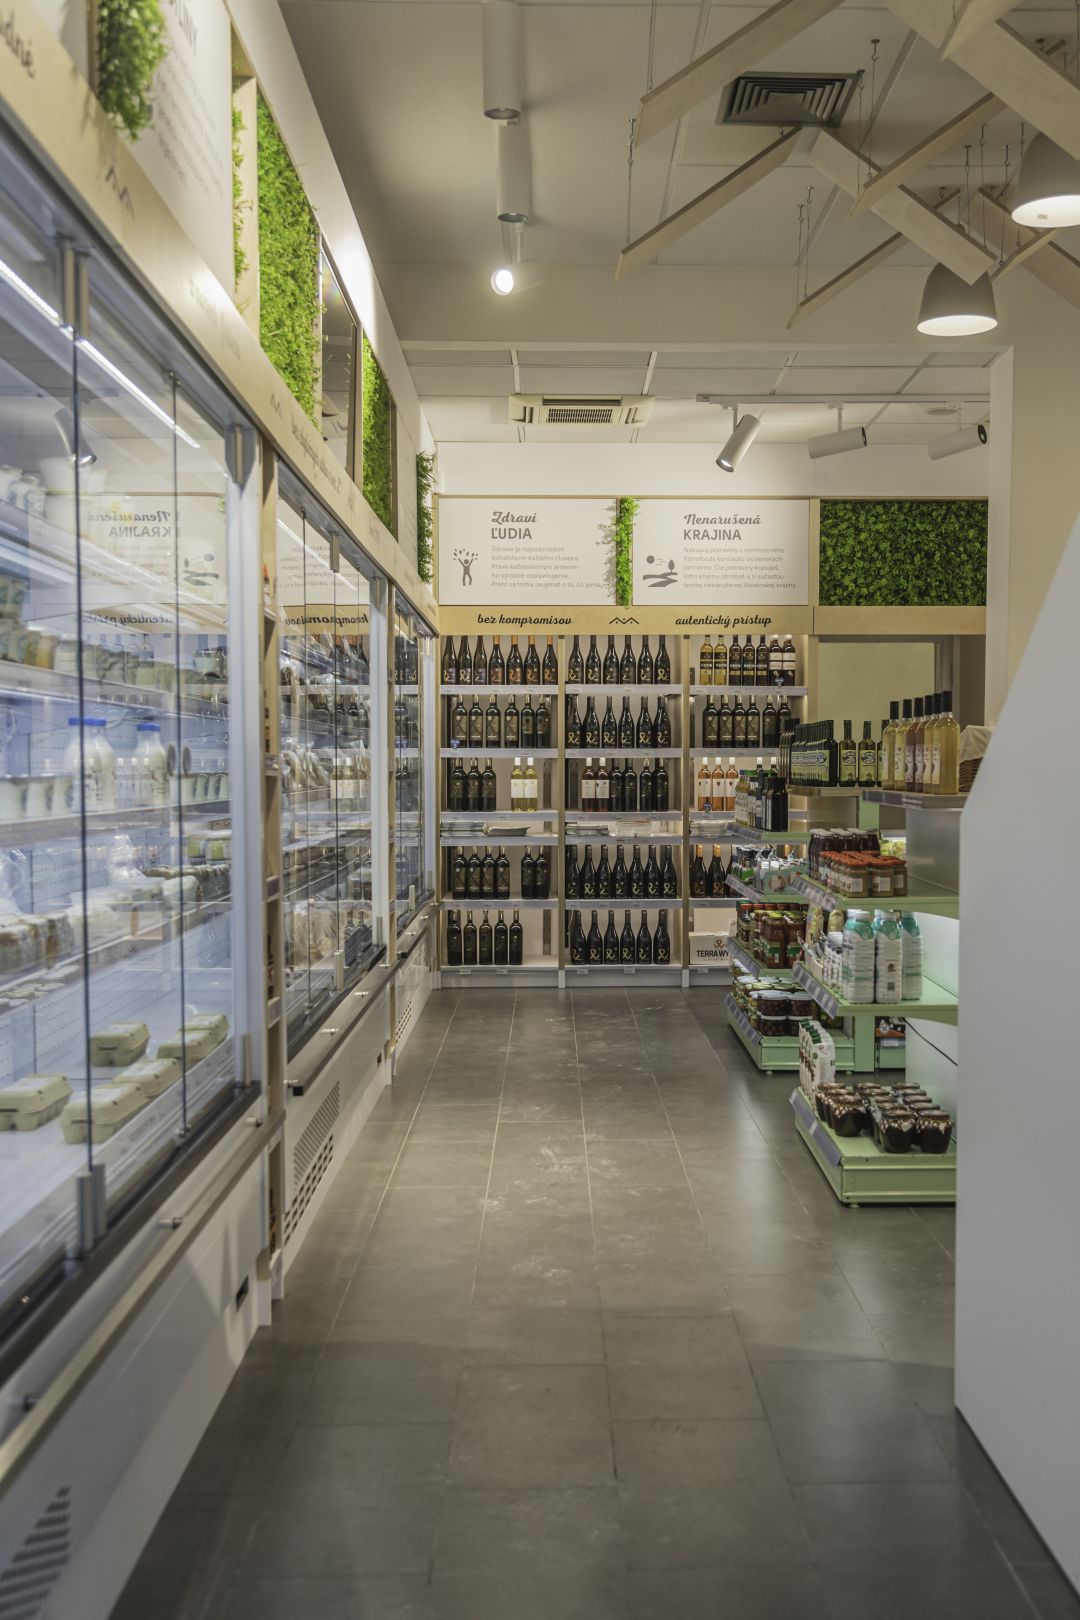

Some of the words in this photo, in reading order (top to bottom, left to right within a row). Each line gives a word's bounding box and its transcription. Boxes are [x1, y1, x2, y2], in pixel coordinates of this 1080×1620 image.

[684, 513, 762, 525] Nenarušená
[491, 527, 532, 539] ĽUDIA
[683, 529, 742, 541] KRAJINA
[477, 613, 497, 624] bez
[498, 613, 574, 628] kompromisov
[675, 614, 731, 628] autentický
[731, 614, 773, 628] prístup
